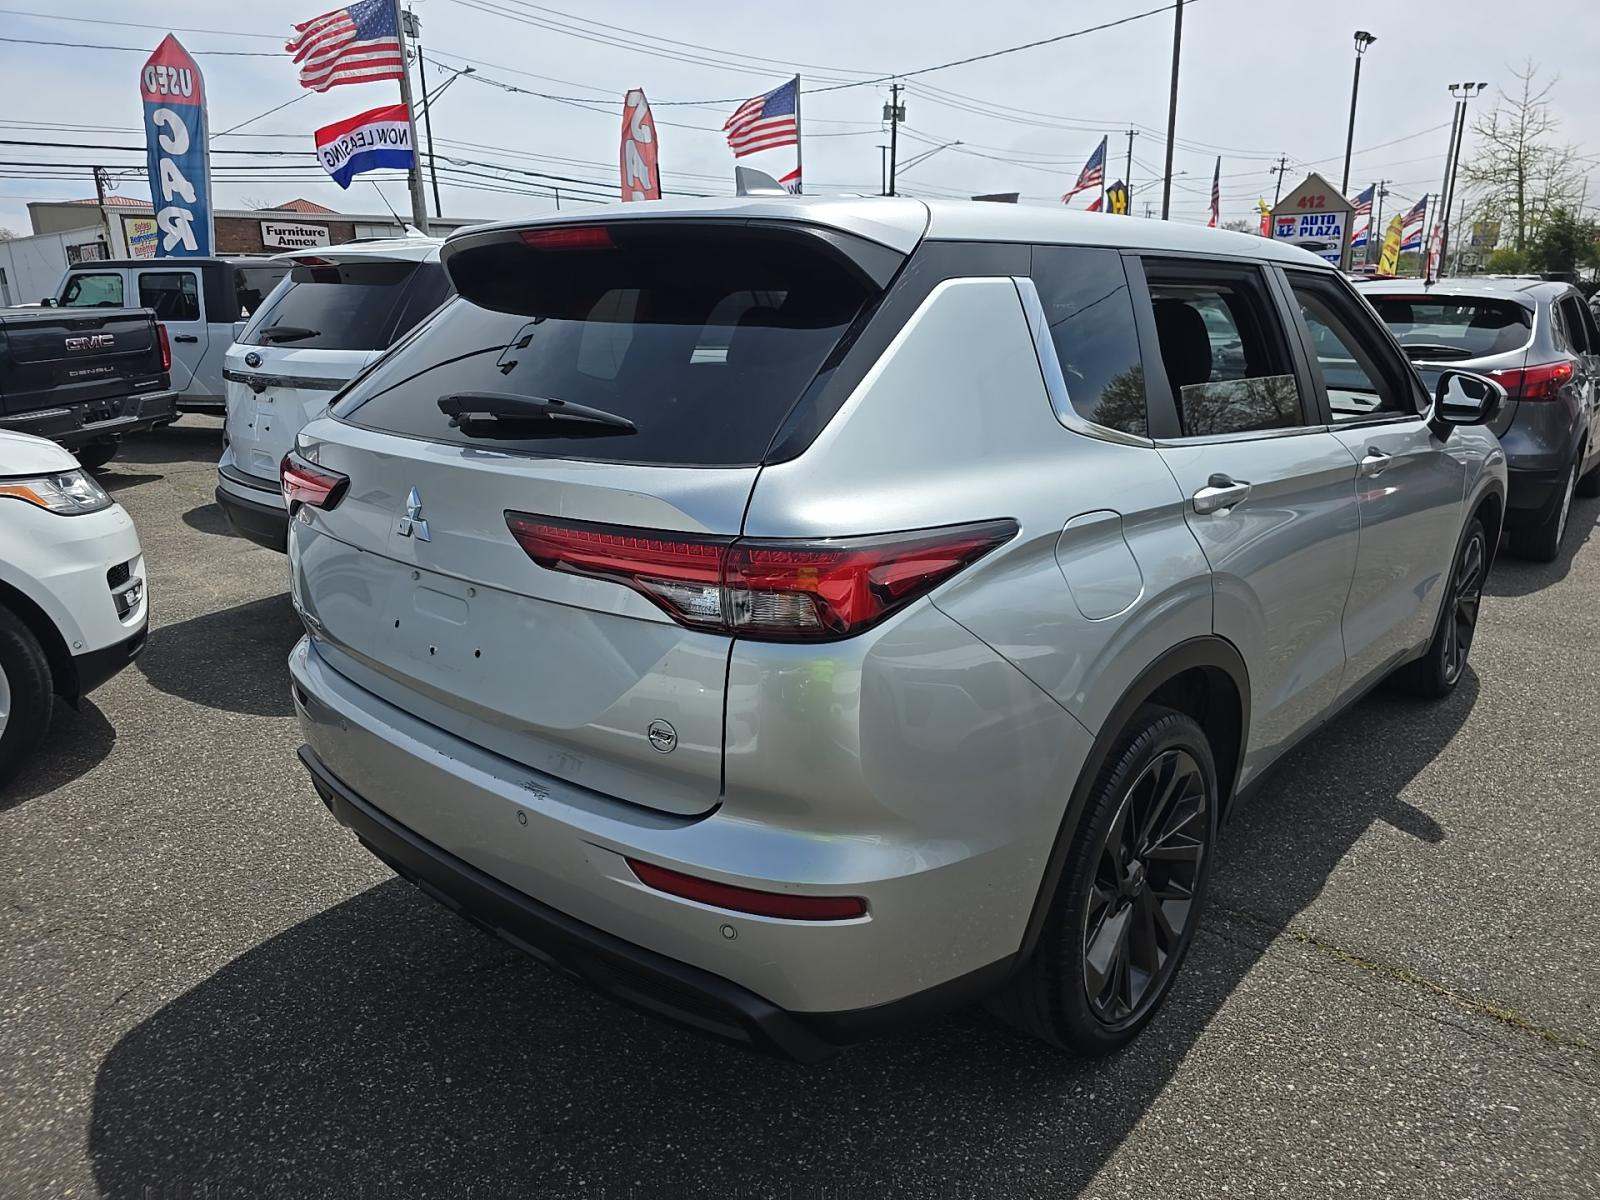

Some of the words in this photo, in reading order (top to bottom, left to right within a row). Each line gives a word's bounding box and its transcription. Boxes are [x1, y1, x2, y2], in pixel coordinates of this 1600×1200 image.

[1297, 194, 1325, 208] 412
[1301, 215, 1336, 226] AUTO
[265, 225, 326, 237] Furniture
[1300, 225, 1341, 237] PLAZA
[277, 236, 318, 247] Annex
[65, 334, 115, 351] GMC
